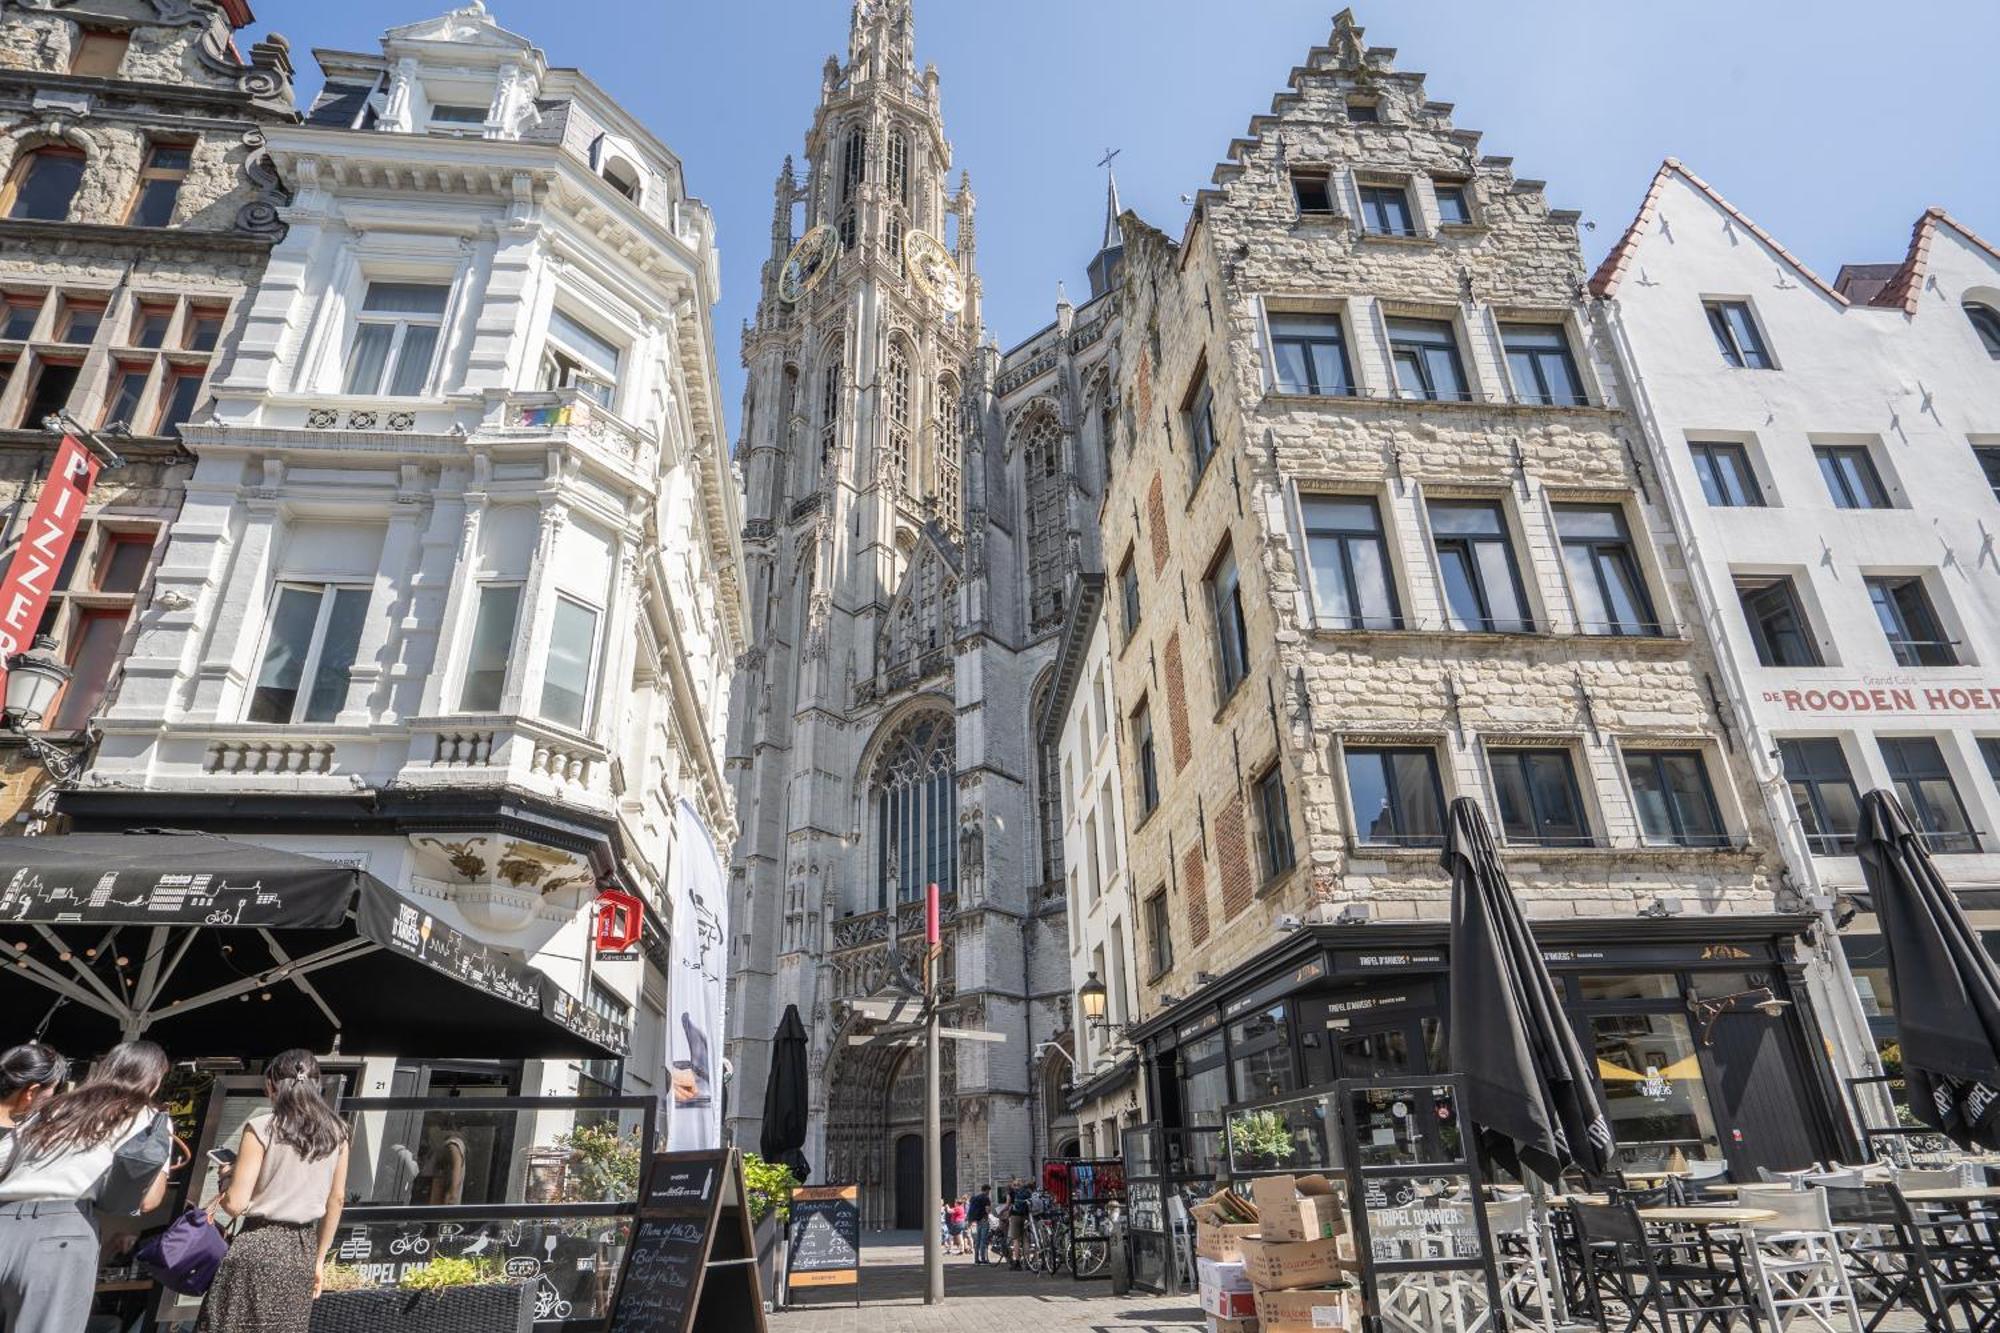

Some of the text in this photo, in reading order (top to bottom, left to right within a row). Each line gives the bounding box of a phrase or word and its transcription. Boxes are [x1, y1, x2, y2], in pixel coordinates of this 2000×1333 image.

[1762, 691, 1782, 702] DE
[1782, 688, 1917, 712] ROODEN
[375, 1081, 386, 1090] 21
[548, 1088, 558, 1097] 21
[1376, 1209, 1413, 1227] TRIPEL
